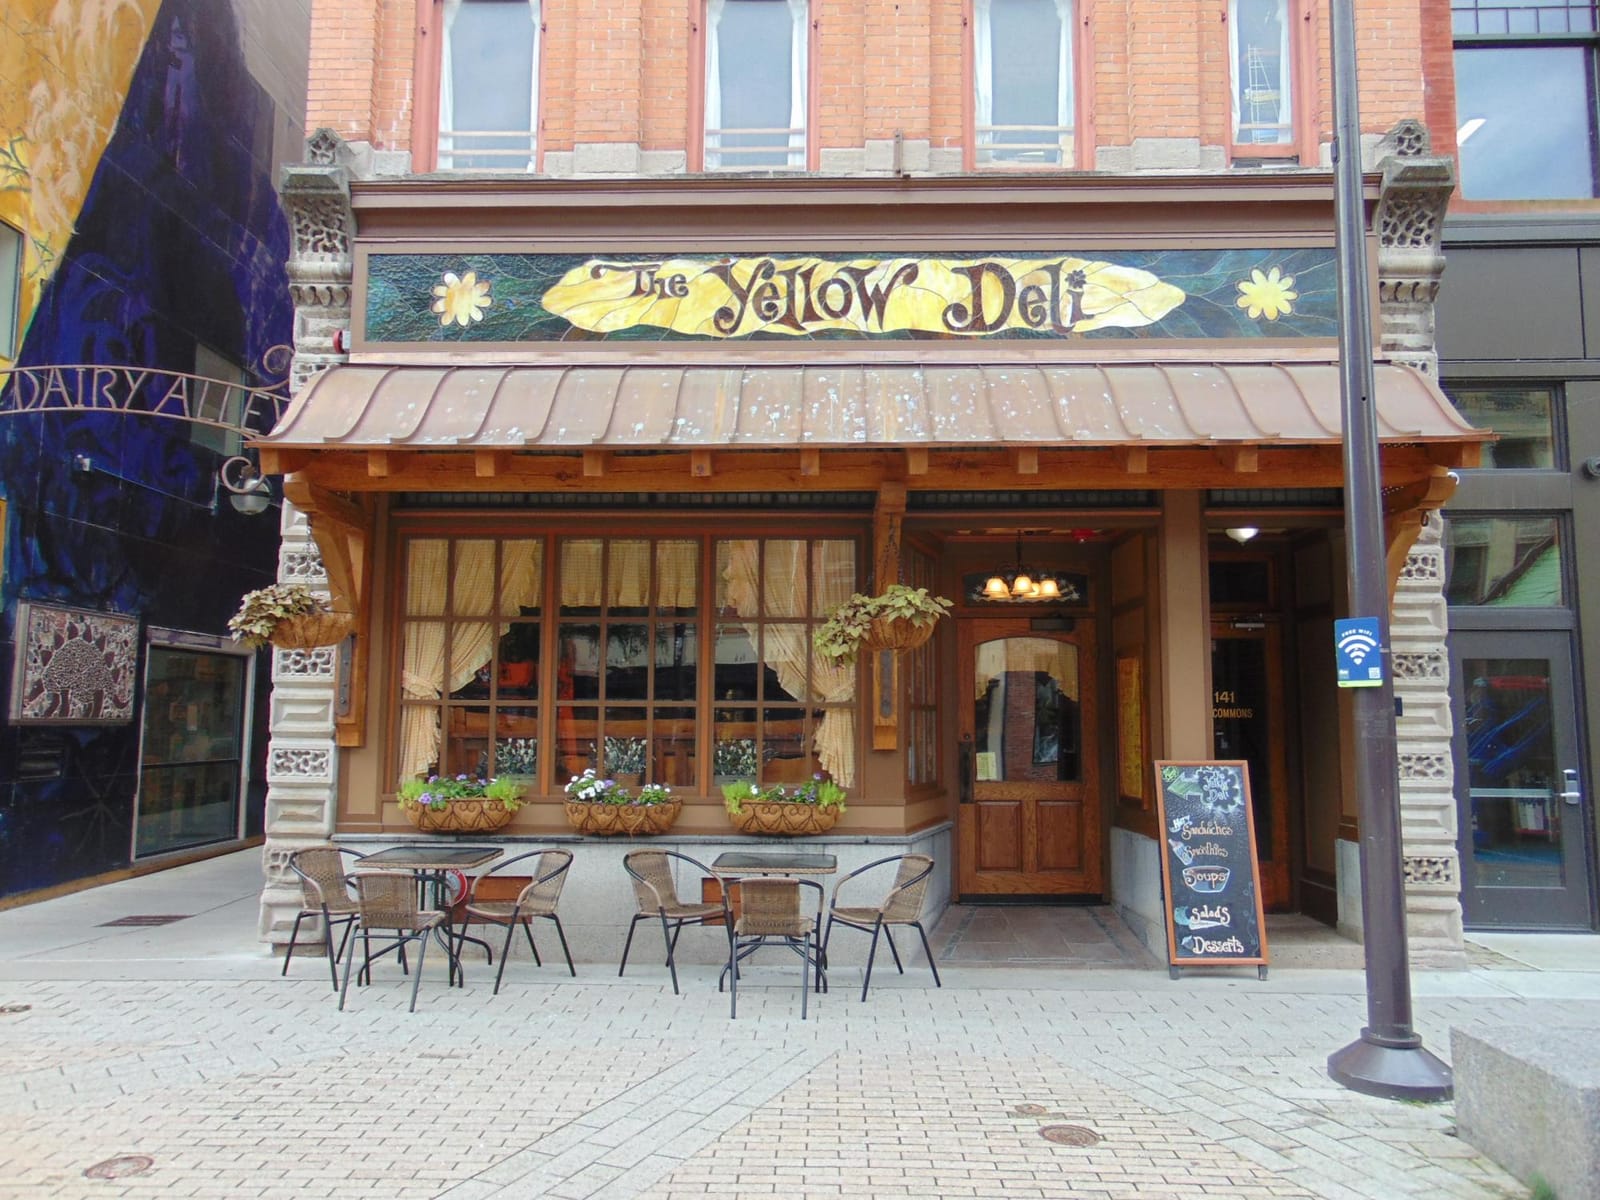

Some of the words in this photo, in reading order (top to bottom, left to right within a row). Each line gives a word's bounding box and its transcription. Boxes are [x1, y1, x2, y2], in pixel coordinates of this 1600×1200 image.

[590, 263, 690, 300] The
[712, 258, 919, 334] Yellow
[941, 258, 1095, 335] Deli
[14, 367, 148, 411] DAIRY
[1341, 628, 1356, 637] FREE
[1214, 690, 1235, 703] 141
[1212, 708, 1253, 719] COMMONS
[1207, 788, 1230, 803] Deli
[1181, 820, 1234, 841] Sandwiches
[1183, 841, 1229, 859] Smoothies
[1183, 869, 1227, 889] Soups
[1192, 935, 1245, 955] Desserts
